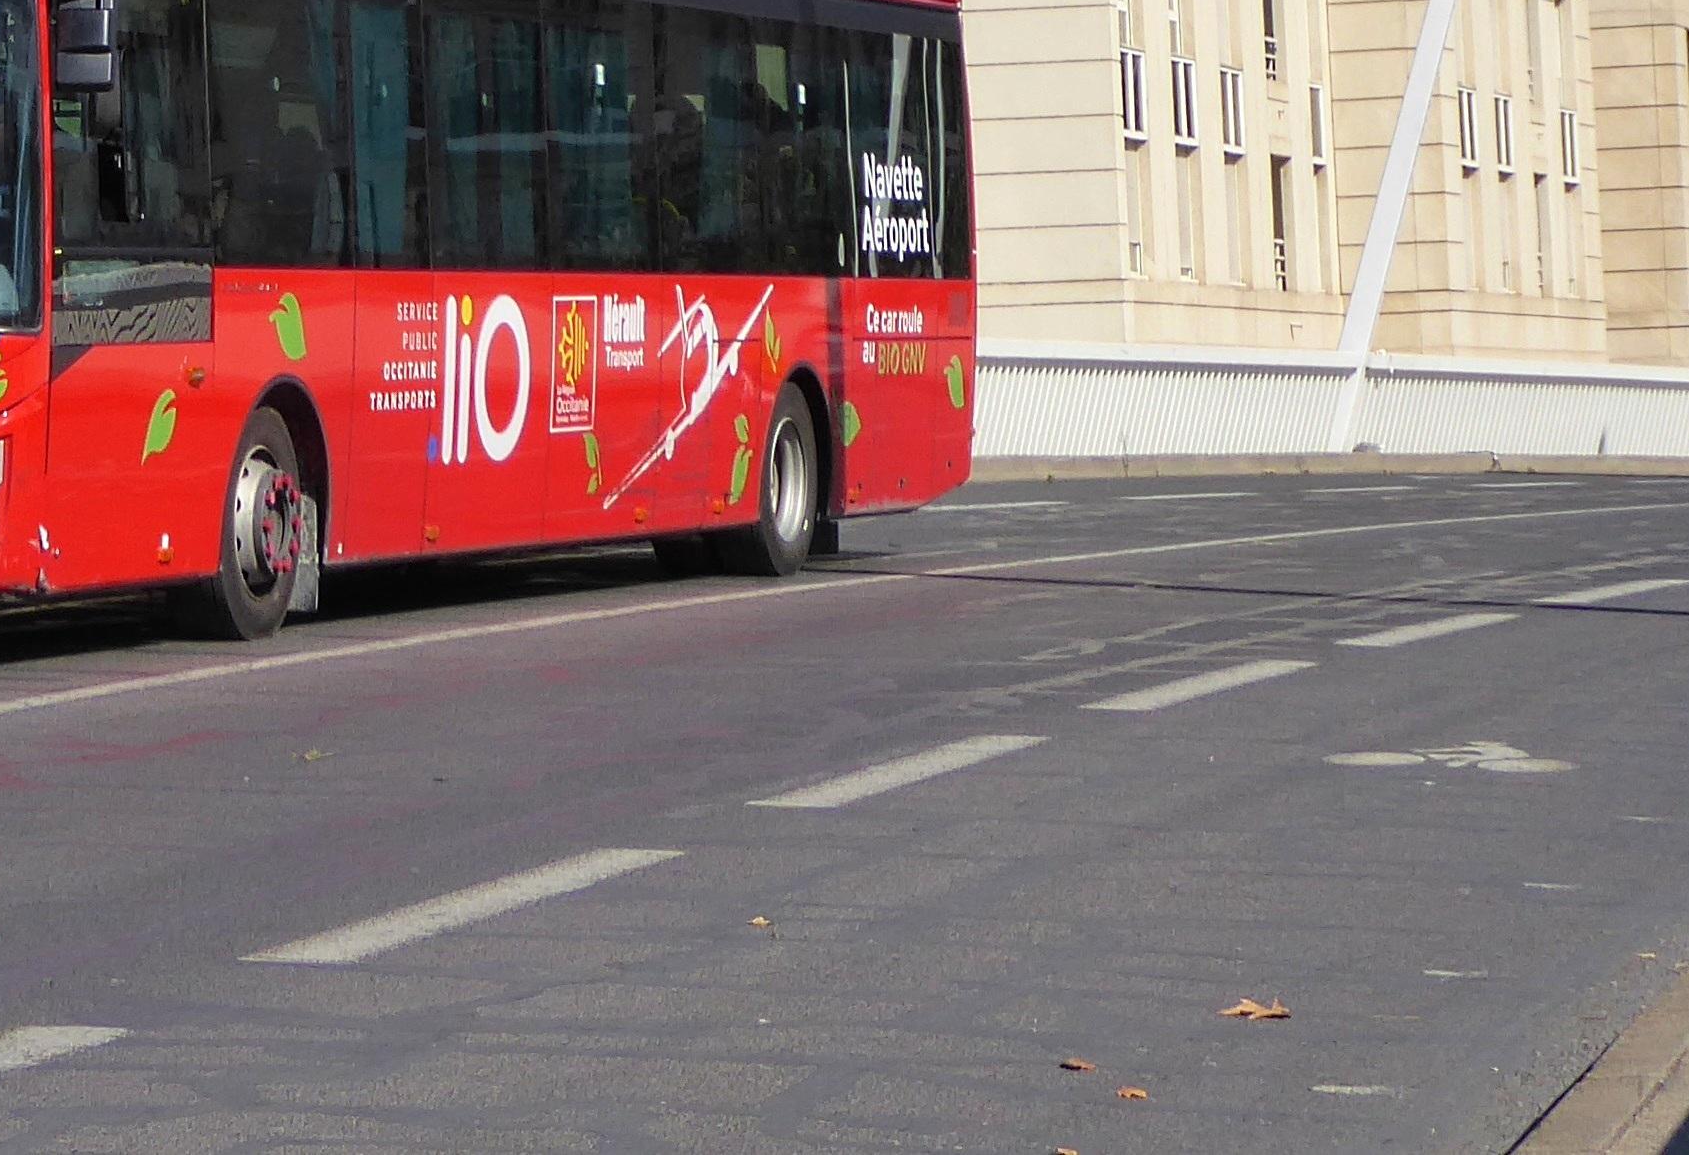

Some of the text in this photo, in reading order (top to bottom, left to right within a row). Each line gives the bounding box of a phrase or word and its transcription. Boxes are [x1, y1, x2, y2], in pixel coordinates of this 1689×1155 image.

[863, 152, 923, 201] Navette
[862, 205, 930, 263] Aéroport
[397, 302, 438, 322] SERVICE
[604, 294, 645, 343] Hérault
[866, 303, 924, 334] Ce car roule
[402, 331, 438, 350] PUBLIC
[383, 360, 438, 381] OCCITANIE
[605, 345, 644, 371] Transport
[862, 341, 927, 376] au BIO GNV
[369, 389, 437, 411] TRANSPORTS
